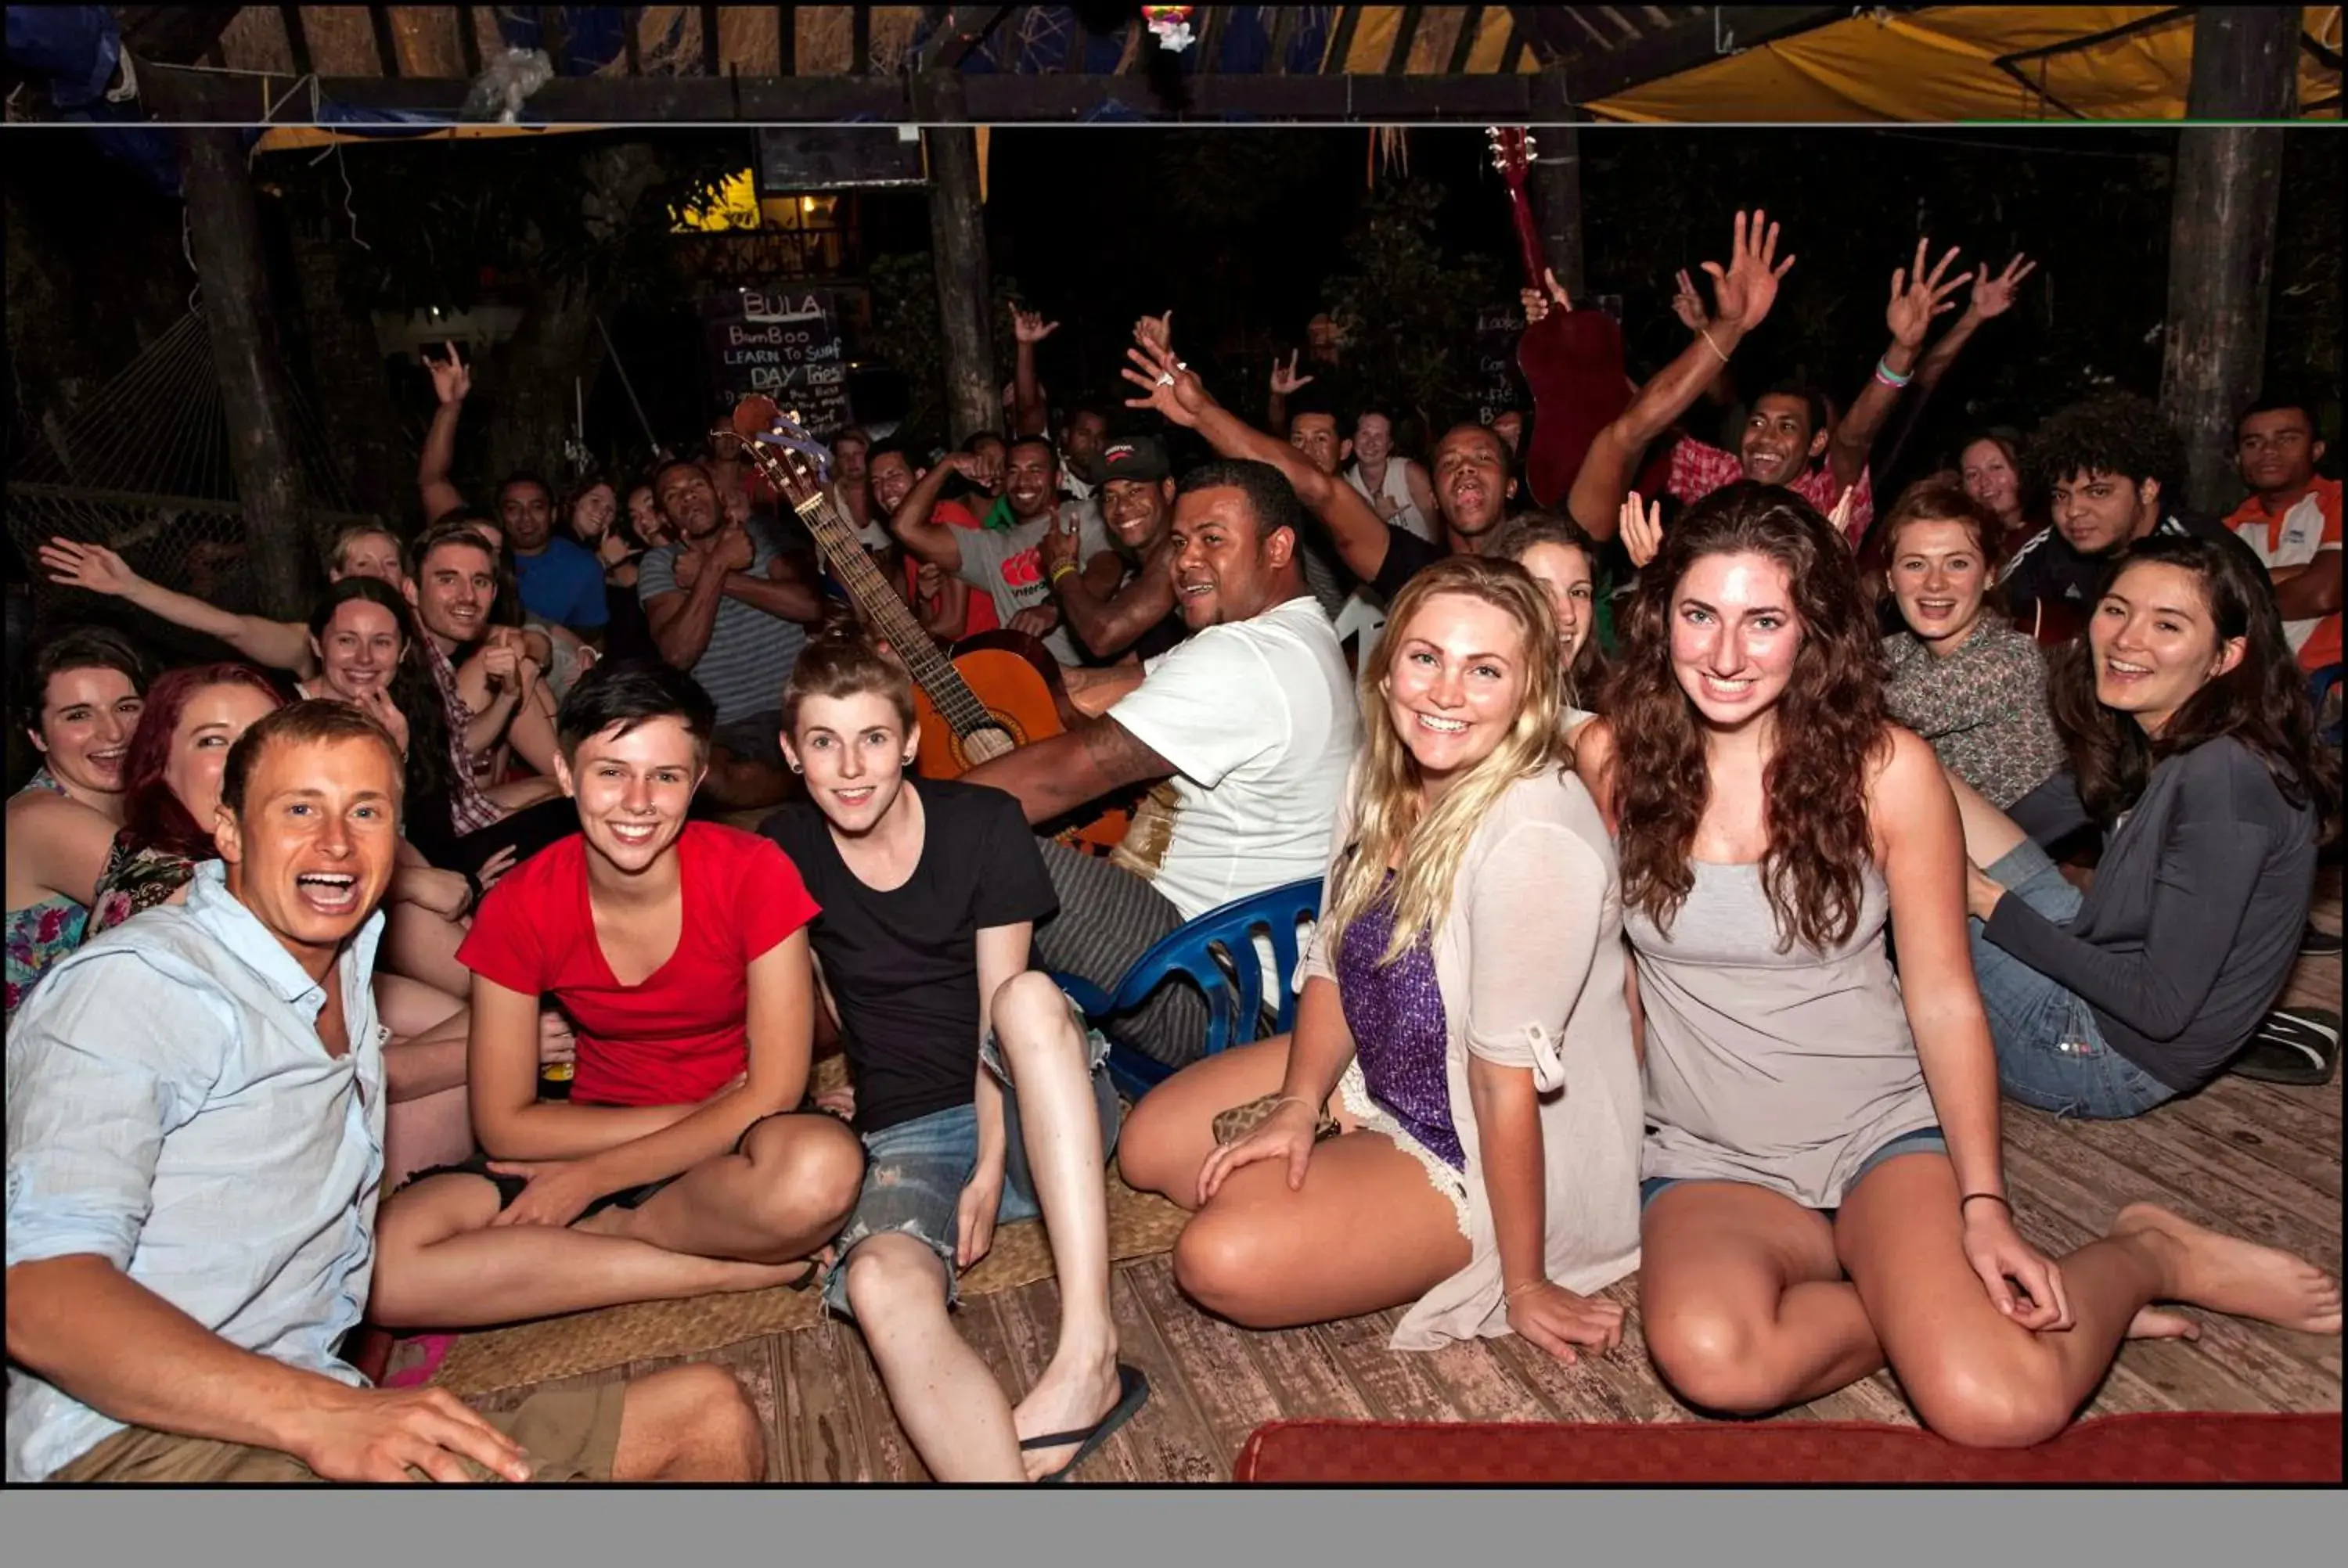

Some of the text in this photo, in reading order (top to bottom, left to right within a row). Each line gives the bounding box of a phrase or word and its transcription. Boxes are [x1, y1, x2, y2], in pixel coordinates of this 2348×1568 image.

[744, 293, 820, 315] BULA
[723, 351, 780, 365] LEARN
[751, 366, 798, 388] DAY
